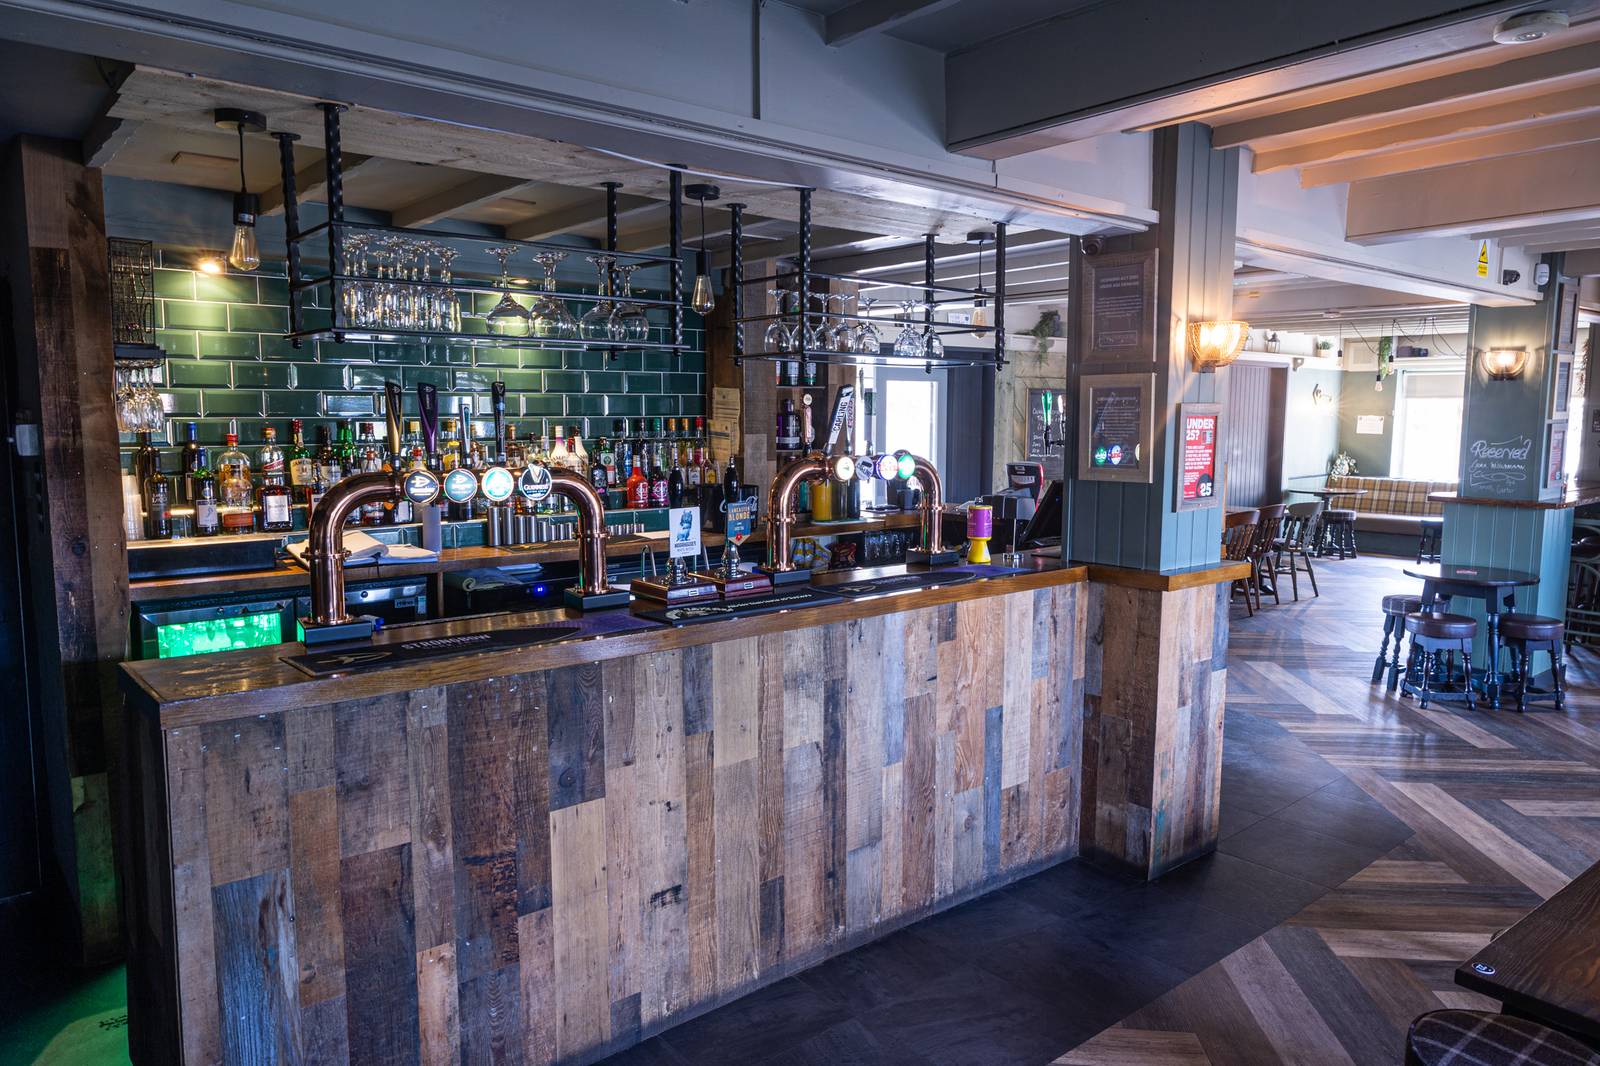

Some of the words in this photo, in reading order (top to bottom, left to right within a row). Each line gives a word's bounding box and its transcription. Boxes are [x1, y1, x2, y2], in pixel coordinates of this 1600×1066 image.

[833, 401, 848, 431] CARLING
[1186, 418, 1214, 429] UNDER
[1186, 430, 1200, 441] 25?
[1470, 439, 1532, 459] Reserved
[1200, 483, 1212, 496] 25
[728, 511, 750, 521] BLONDE
[401, 633, 492, 650] STRONGBOW
